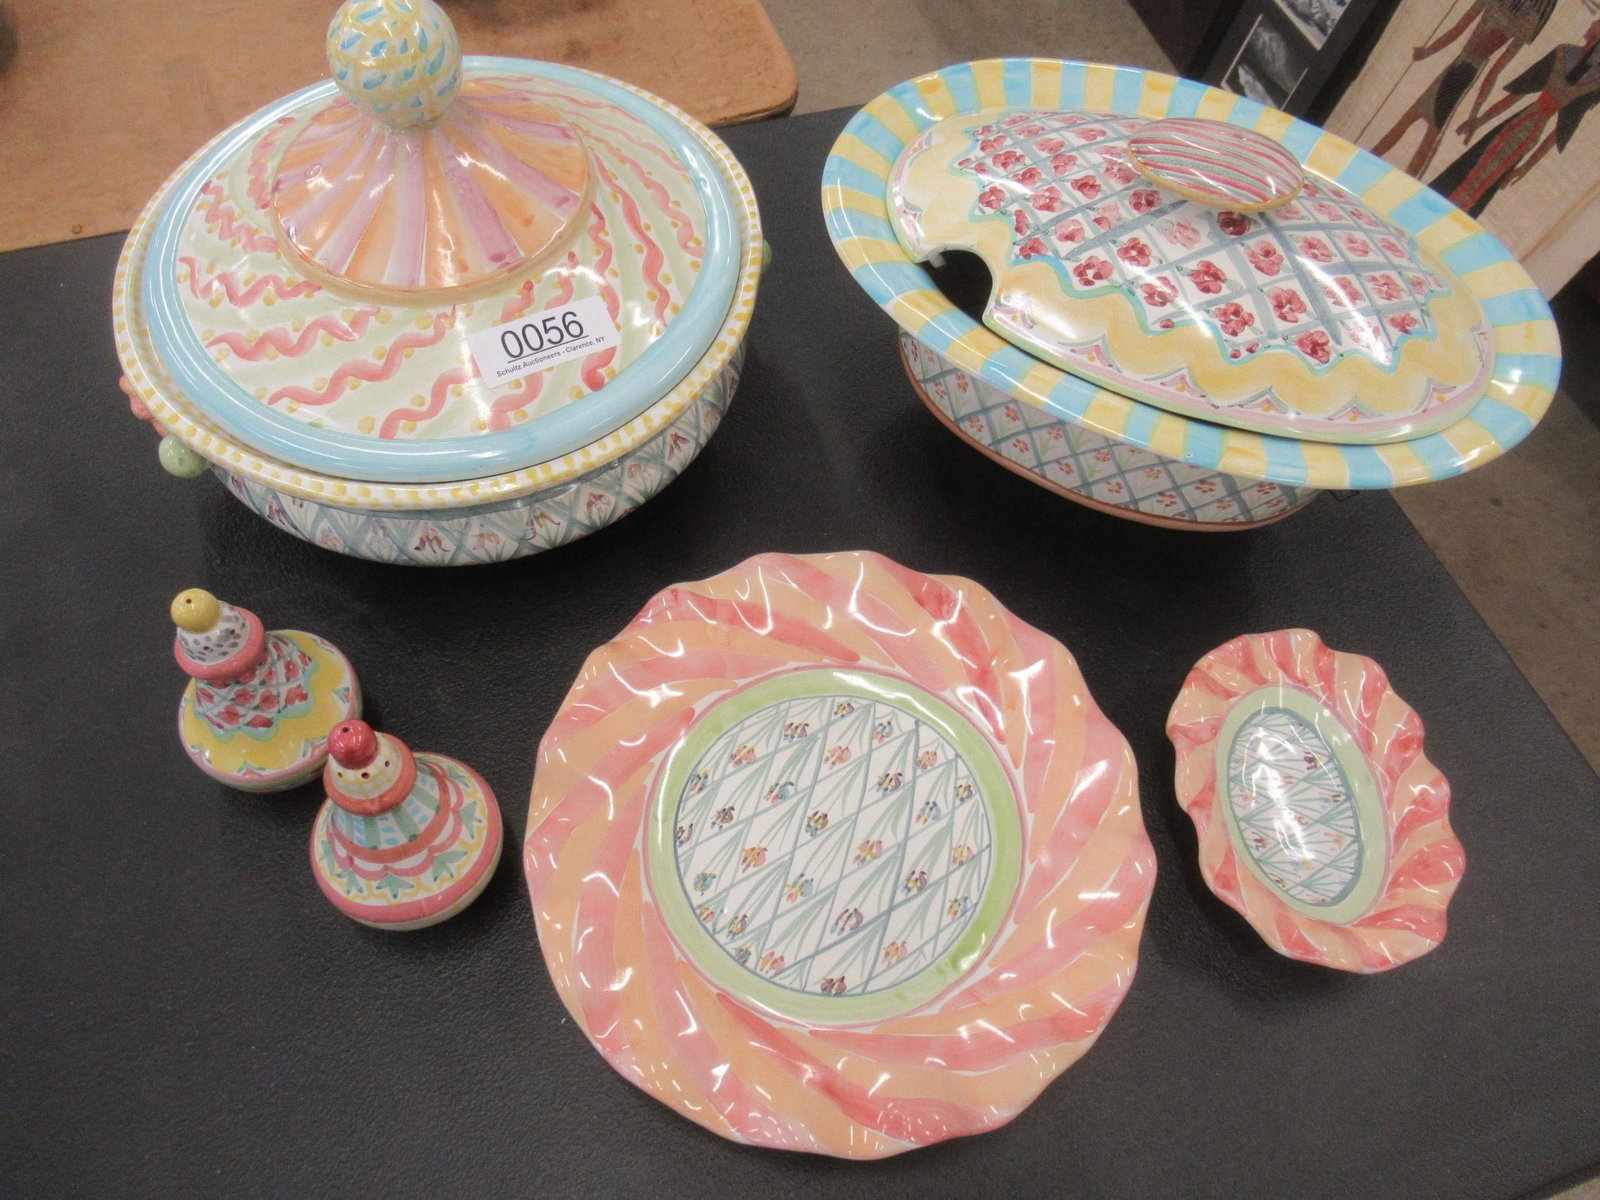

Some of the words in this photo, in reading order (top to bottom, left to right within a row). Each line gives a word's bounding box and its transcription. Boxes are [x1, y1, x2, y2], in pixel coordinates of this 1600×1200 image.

[501, 311, 584, 359] 0056
[496, 364, 522, 378] Schultz
[522, 350, 561, 368] Auctioneers
[566, 340, 596, 353] Clarence,
